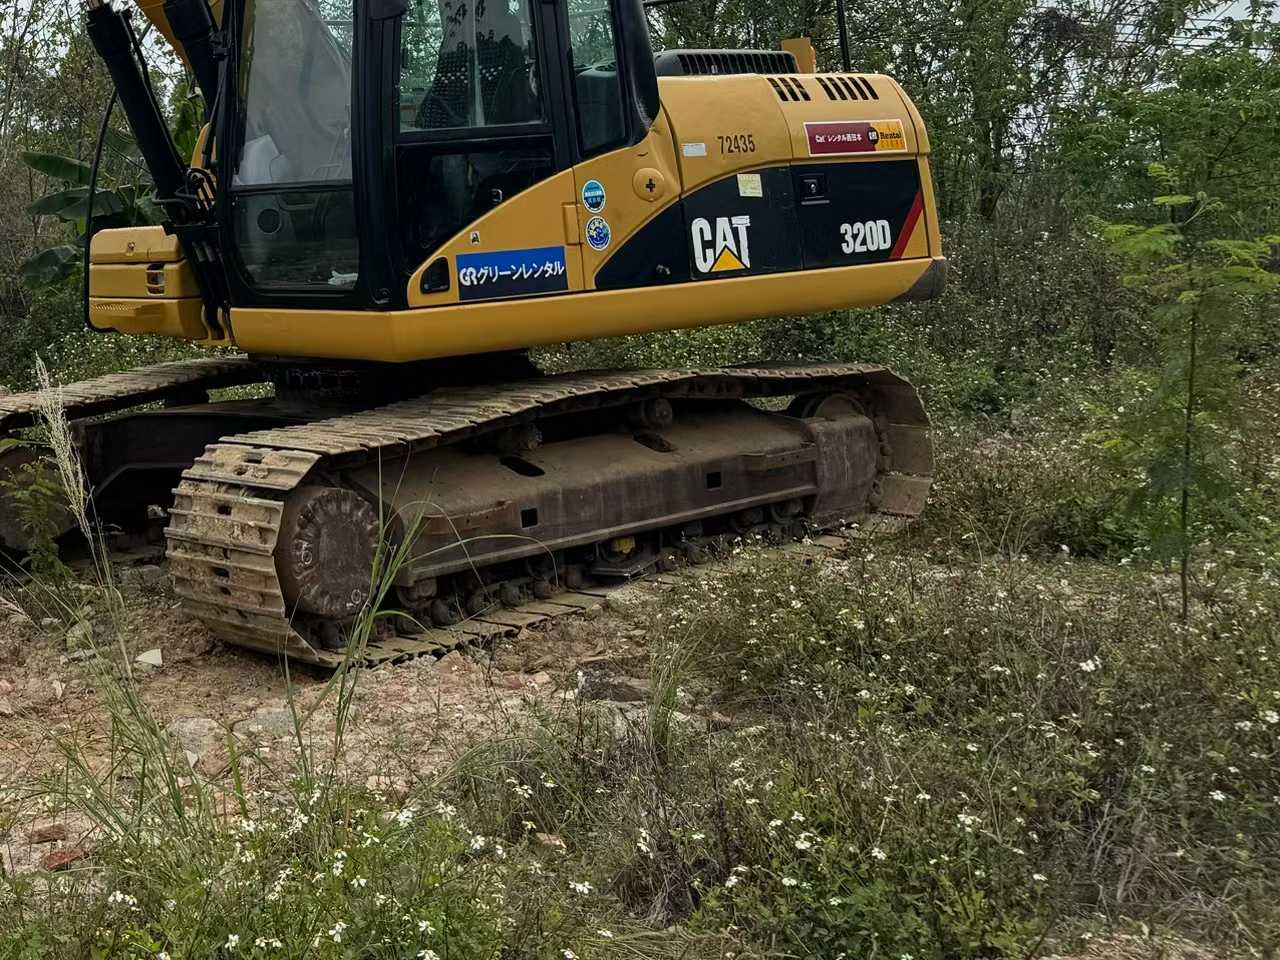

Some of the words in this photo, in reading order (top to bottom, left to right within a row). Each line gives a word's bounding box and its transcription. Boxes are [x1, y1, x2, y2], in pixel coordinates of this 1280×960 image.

[717, 134, 756, 154] 72435
[691, 215, 751, 273] CAT
[840, 219, 892, 254] 320D
